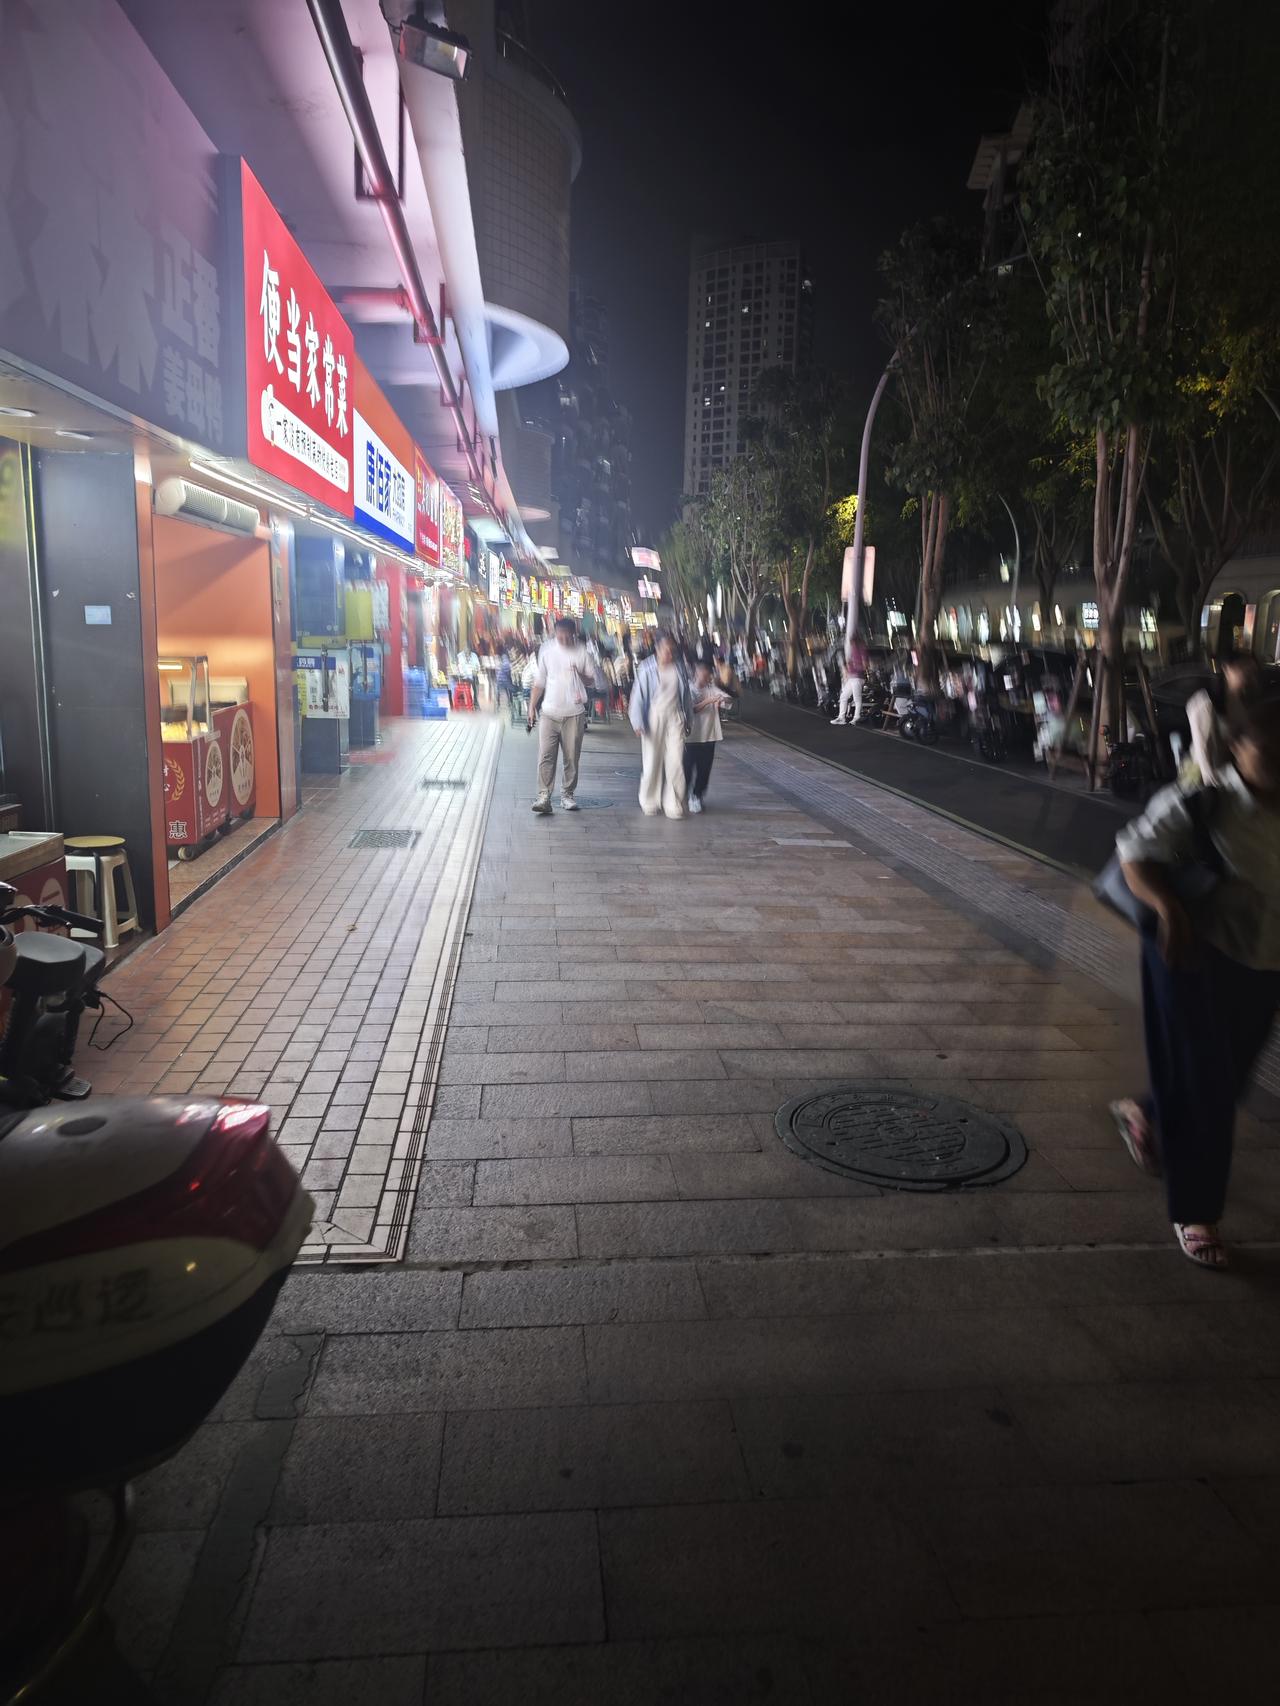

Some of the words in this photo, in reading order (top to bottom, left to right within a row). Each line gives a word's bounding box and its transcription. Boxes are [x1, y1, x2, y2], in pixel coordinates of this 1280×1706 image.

[260, 249, 348, 438] 便当家常菜
[169, 820, 188, 840] 惠
